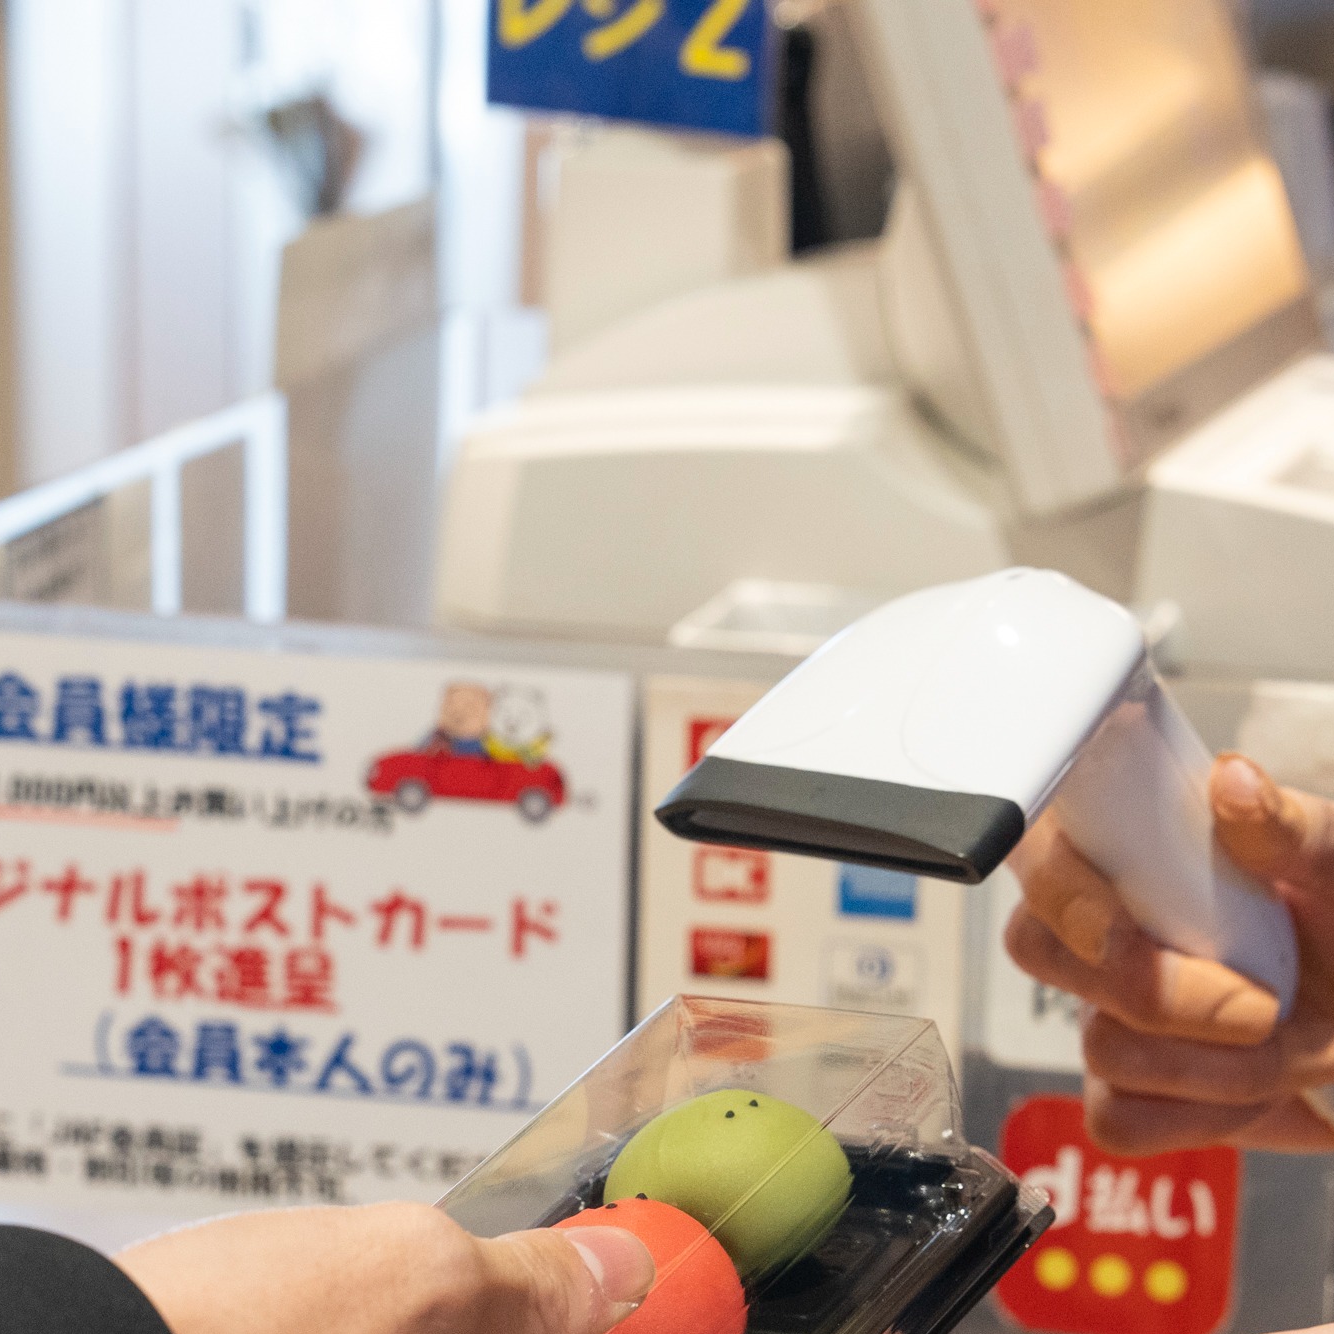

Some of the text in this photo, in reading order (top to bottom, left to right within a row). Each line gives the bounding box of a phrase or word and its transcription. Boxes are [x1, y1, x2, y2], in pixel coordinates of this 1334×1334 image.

[115, 934, 335, 1006] 1枚進呈
[1019, 1146, 1219, 1240] d払い
